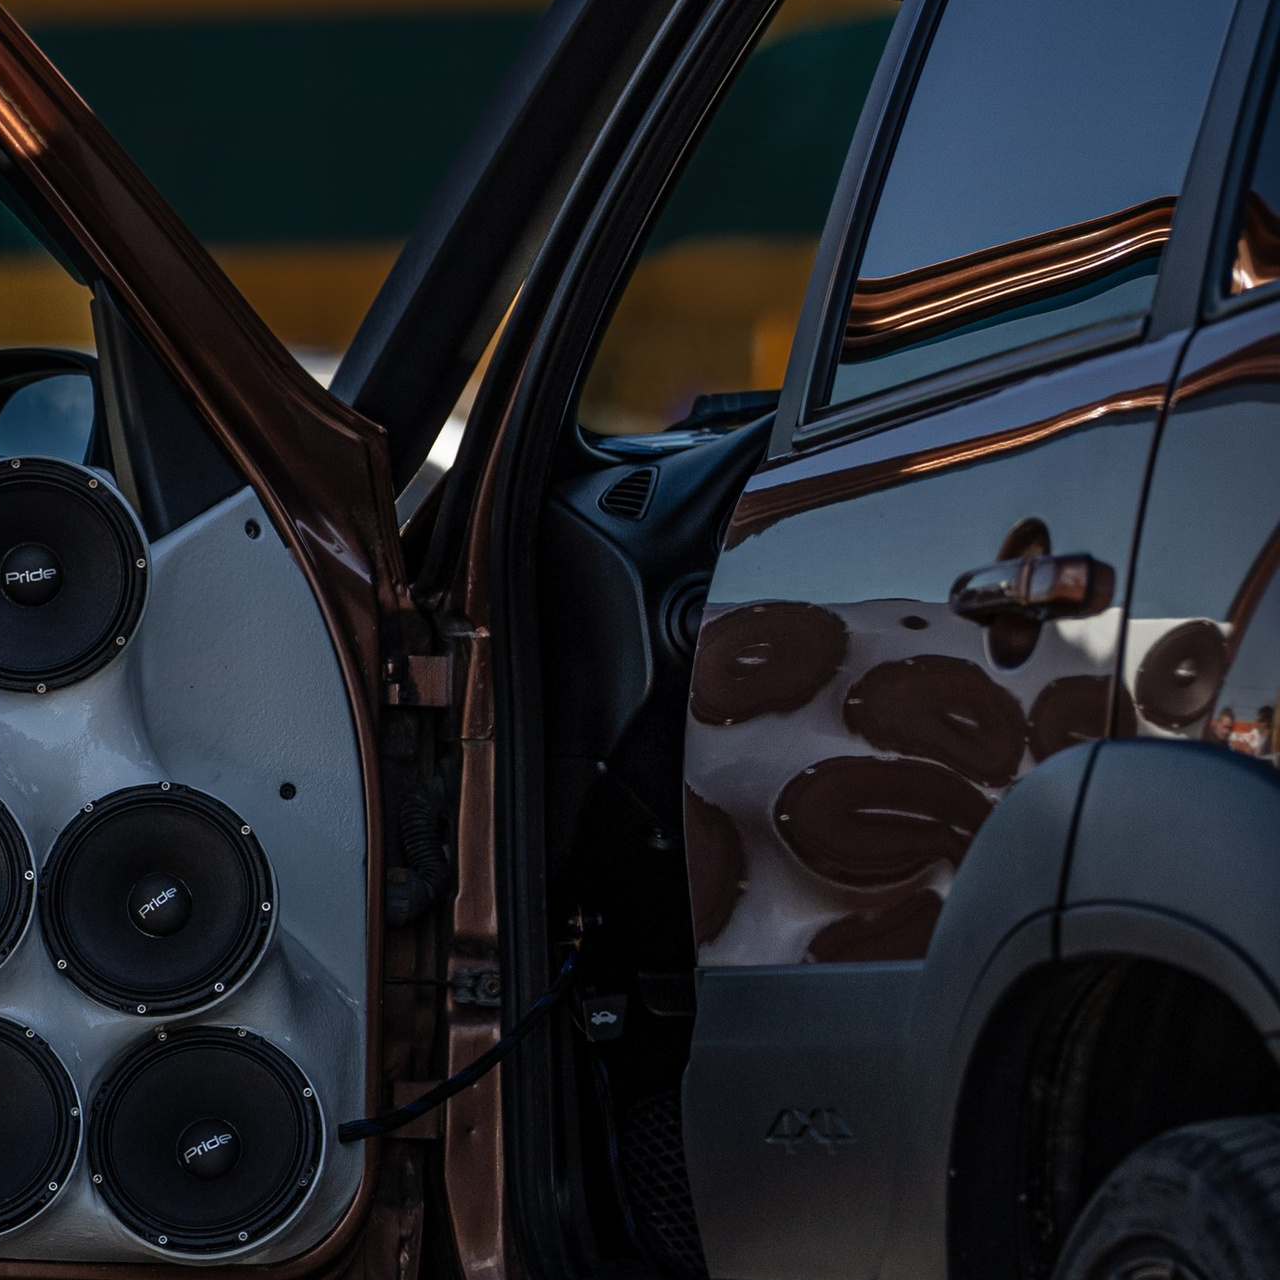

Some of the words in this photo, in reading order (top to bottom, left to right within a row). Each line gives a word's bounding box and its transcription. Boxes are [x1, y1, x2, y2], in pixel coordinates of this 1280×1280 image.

[6, 568, 56, 584] Pride
[139, 888, 177, 918] Pride
[184, 1135, 232, 1163] Pride
